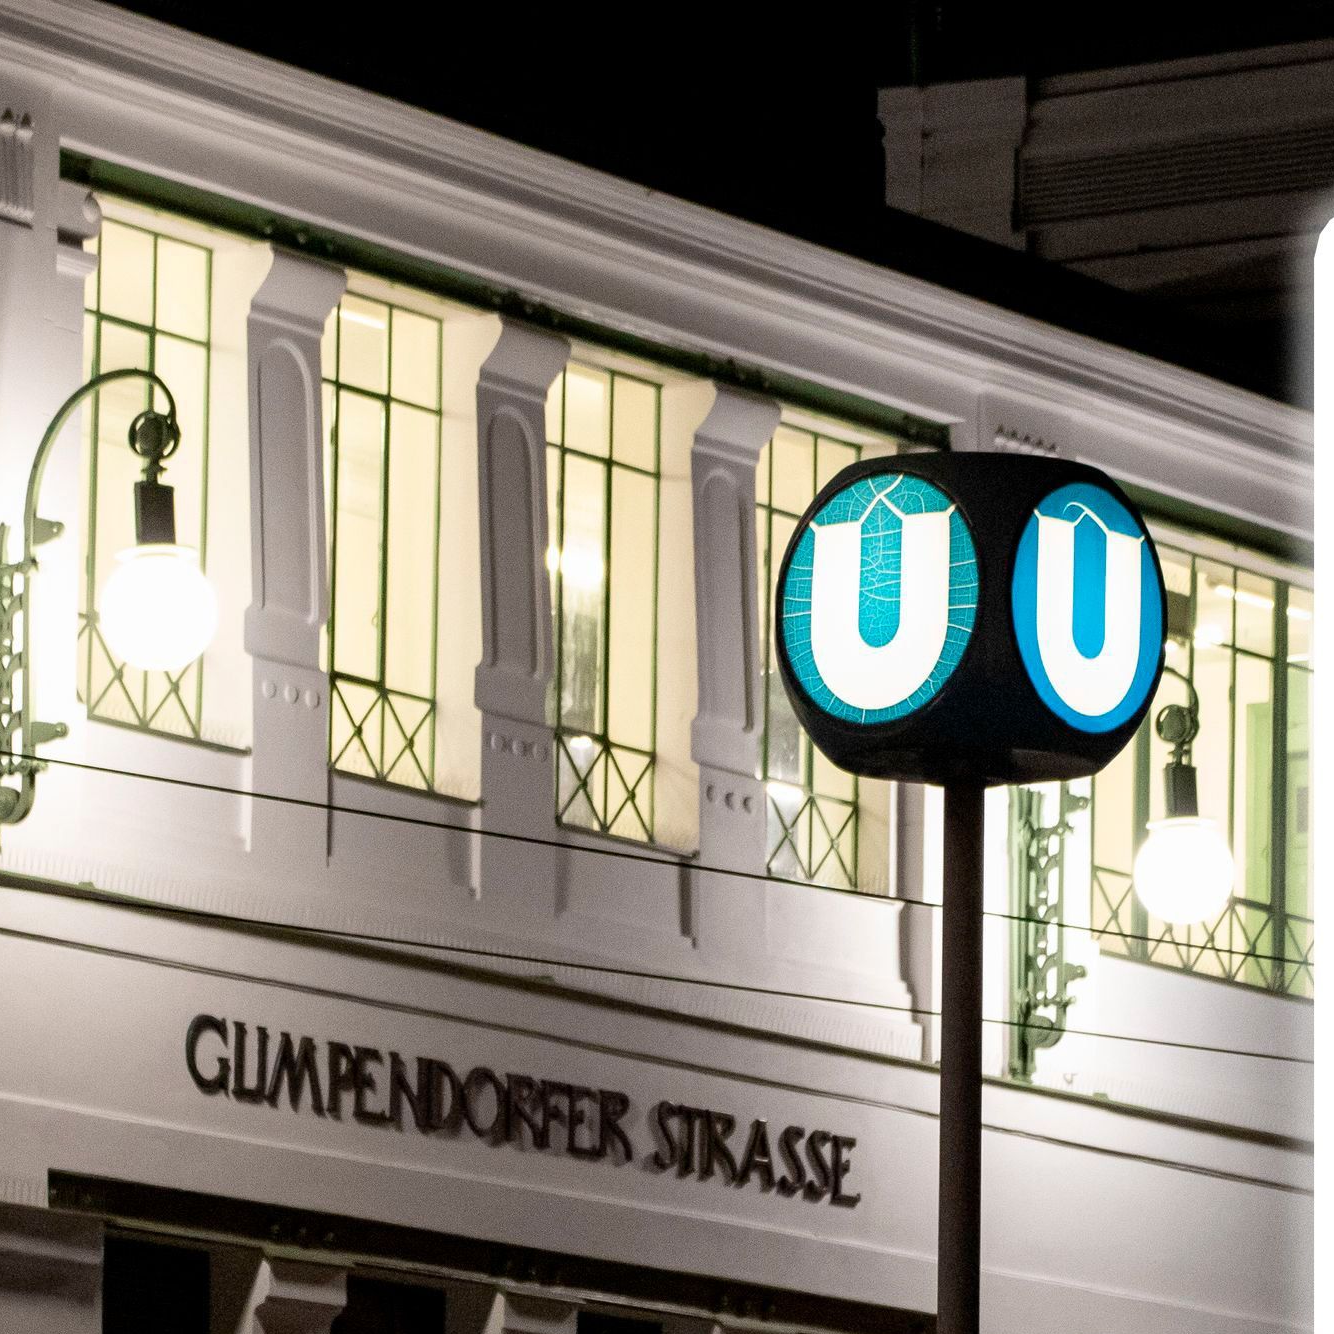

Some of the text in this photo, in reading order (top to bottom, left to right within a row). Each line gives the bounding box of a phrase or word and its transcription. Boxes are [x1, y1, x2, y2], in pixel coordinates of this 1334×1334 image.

[810, 512, 952, 710] U
[1035, 515, 1142, 717] U
[185, 1014, 861, 1207] GUMPENDORFER STRASSE
